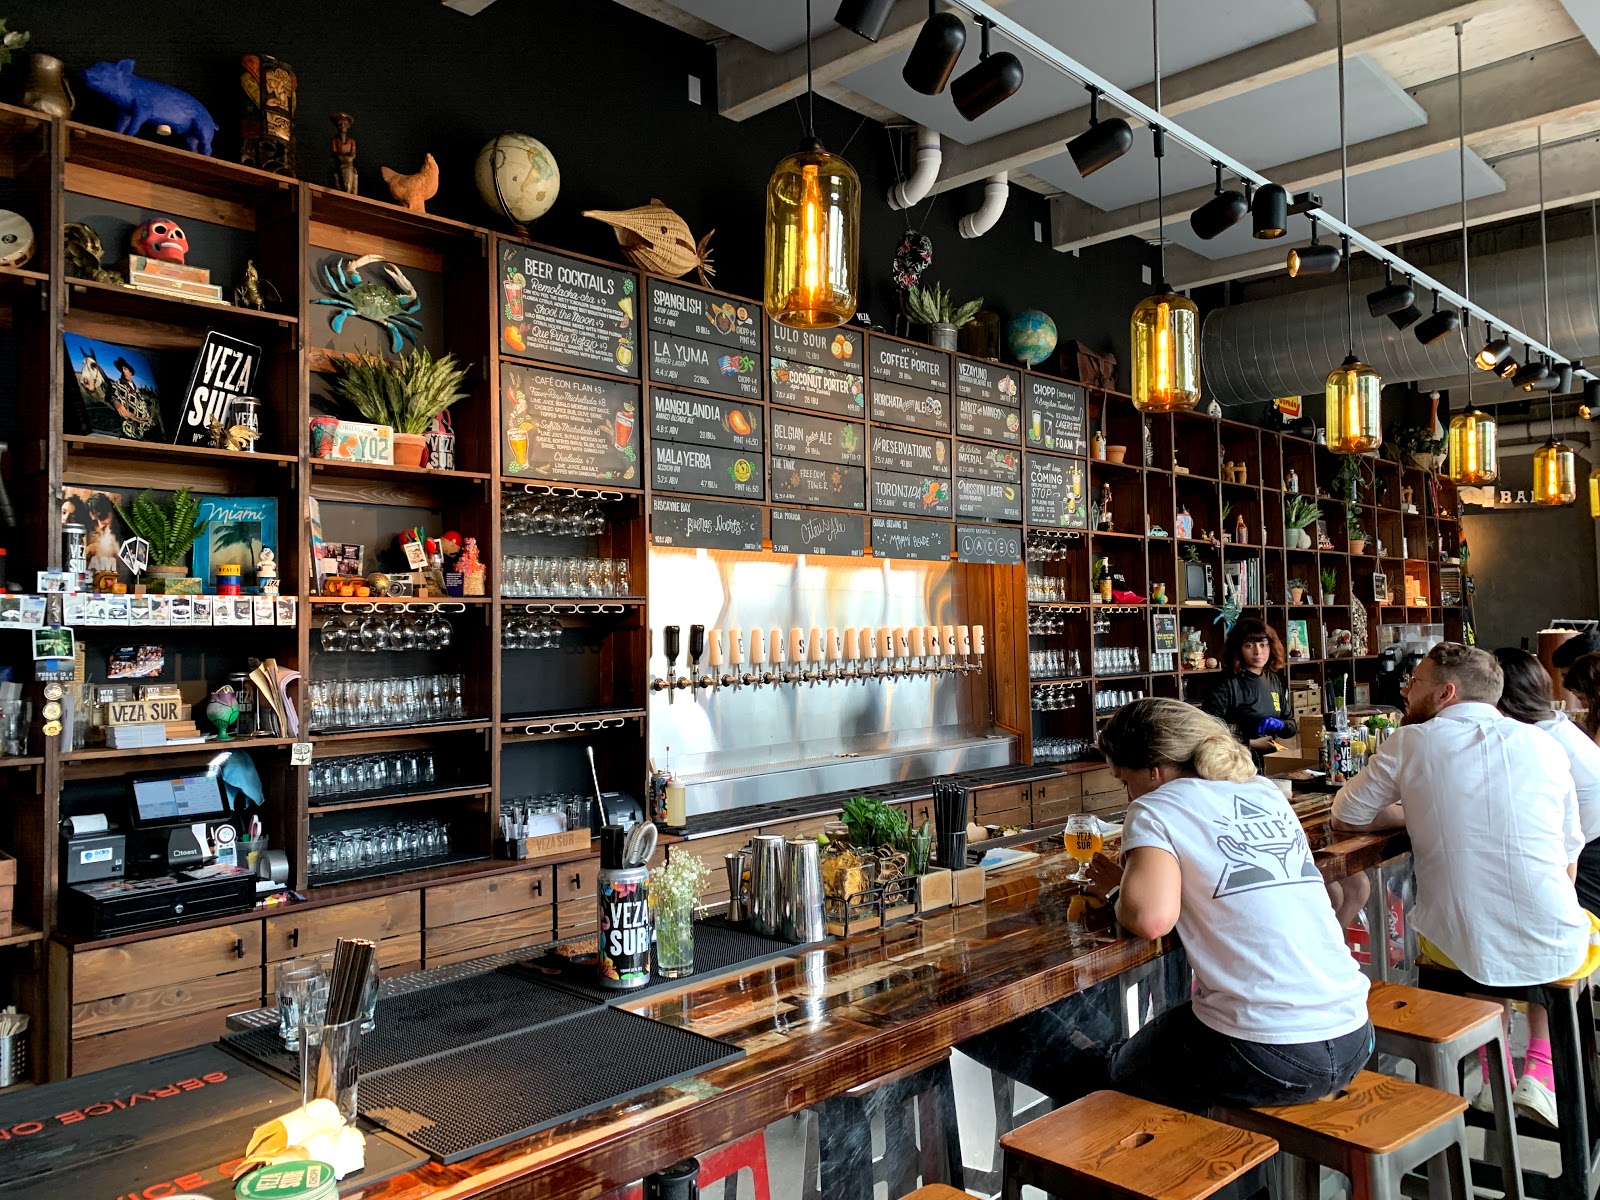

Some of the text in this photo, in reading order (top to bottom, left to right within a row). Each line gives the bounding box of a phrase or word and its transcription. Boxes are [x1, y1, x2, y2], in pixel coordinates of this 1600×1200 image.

[524, 257, 614, 295] BEER COCKTAILS
[653, 288, 701, 315] SPANGLISH
[534, 303, 556, 316] Shoot
[559, 308, 570, 319] the
[572, 311, 594, 325] Moon
[654, 306, 679, 317] LATIN LAGER
[531, 325, 548, 337] Que
[549, 328, 568, 341] Piña
[736, 326, 748, 335] CHOPP
[773, 324, 826, 349] LULO SOUR
[739, 336, 748, 344] PINT
[654, 339, 708, 365] LA YUMA
[203, 343, 253, 394] VEZA
[654, 356, 686, 367] AMBER LAGER
[880, 350, 939, 376] COFFEE PORTER
[534, 374, 553, 385] CAFÉ
[555, 380, 570, 388] CON
[573, 383, 592, 392] FLAN
[737, 375, 750, 383] CHOPP
[789, 370, 848, 393] COCONUT PORTER
[741, 383, 750, 391] PINT
[1033, 382, 1055, 398] CHOPP
[564, 392, 596, 405] Michelada
[873, 392, 902, 409] HORCHATA
[914, 400, 925, 413] ALE
[655, 396, 720, 421] MANGOLANDIA
[982, 405, 1001, 419] MANGO
[235, 412, 259, 427] VEZA
[561, 423, 593, 435] Michelada
[668, 427, 678, 435] ABV
[774, 423, 803, 441] BELGIAN
[818, 431, 832, 445] ALE
[431, 435, 454, 453] VEZA
[881, 439, 931, 458] RESERVATIONS
[1055, 437, 1073, 450] FOAM
[430, 452, 453, 466] SUR
[553, 452, 582, 463] Chelada
[656, 447, 711, 468] MALAYERBA
[772, 458, 795, 470] THE TANK
[959, 452, 983, 464] IMPERIAL
[1030, 460, 1041, 471] They
[1042, 462, 1051, 470] will
[669, 476, 678, 484] ABV
[800, 468, 825, 480] FREEDOM
[1030, 471, 1062, 484] COMING
[806, 480, 828, 490] TOWER
[986, 485, 1002, 497] LAGER
[1031, 487, 1051, 499] STOP
[653, 499, 690, 513] BISCAYNE BAY
[203, 503, 266, 524] Miami
[715, 514, 741, 535] Noches
[70, 544, 86, 559] VE
[70, 559, 86, 573] SU
[111, 702, 178, 722] VEZA SUR
[1341, 746, 1351, 759] VE
[1076, 831, 1092, 841] VEZA
[1234, 819, 1288, 842] HUF
[536, 834, 574, 851] VEZA SUR
[1076, 841, 1092, 849] SUR
[610, 899, 649, 929] VEZA
[609, 928, 648, 956] SUR
[55, 1071, 228, 1125] SERVICE
